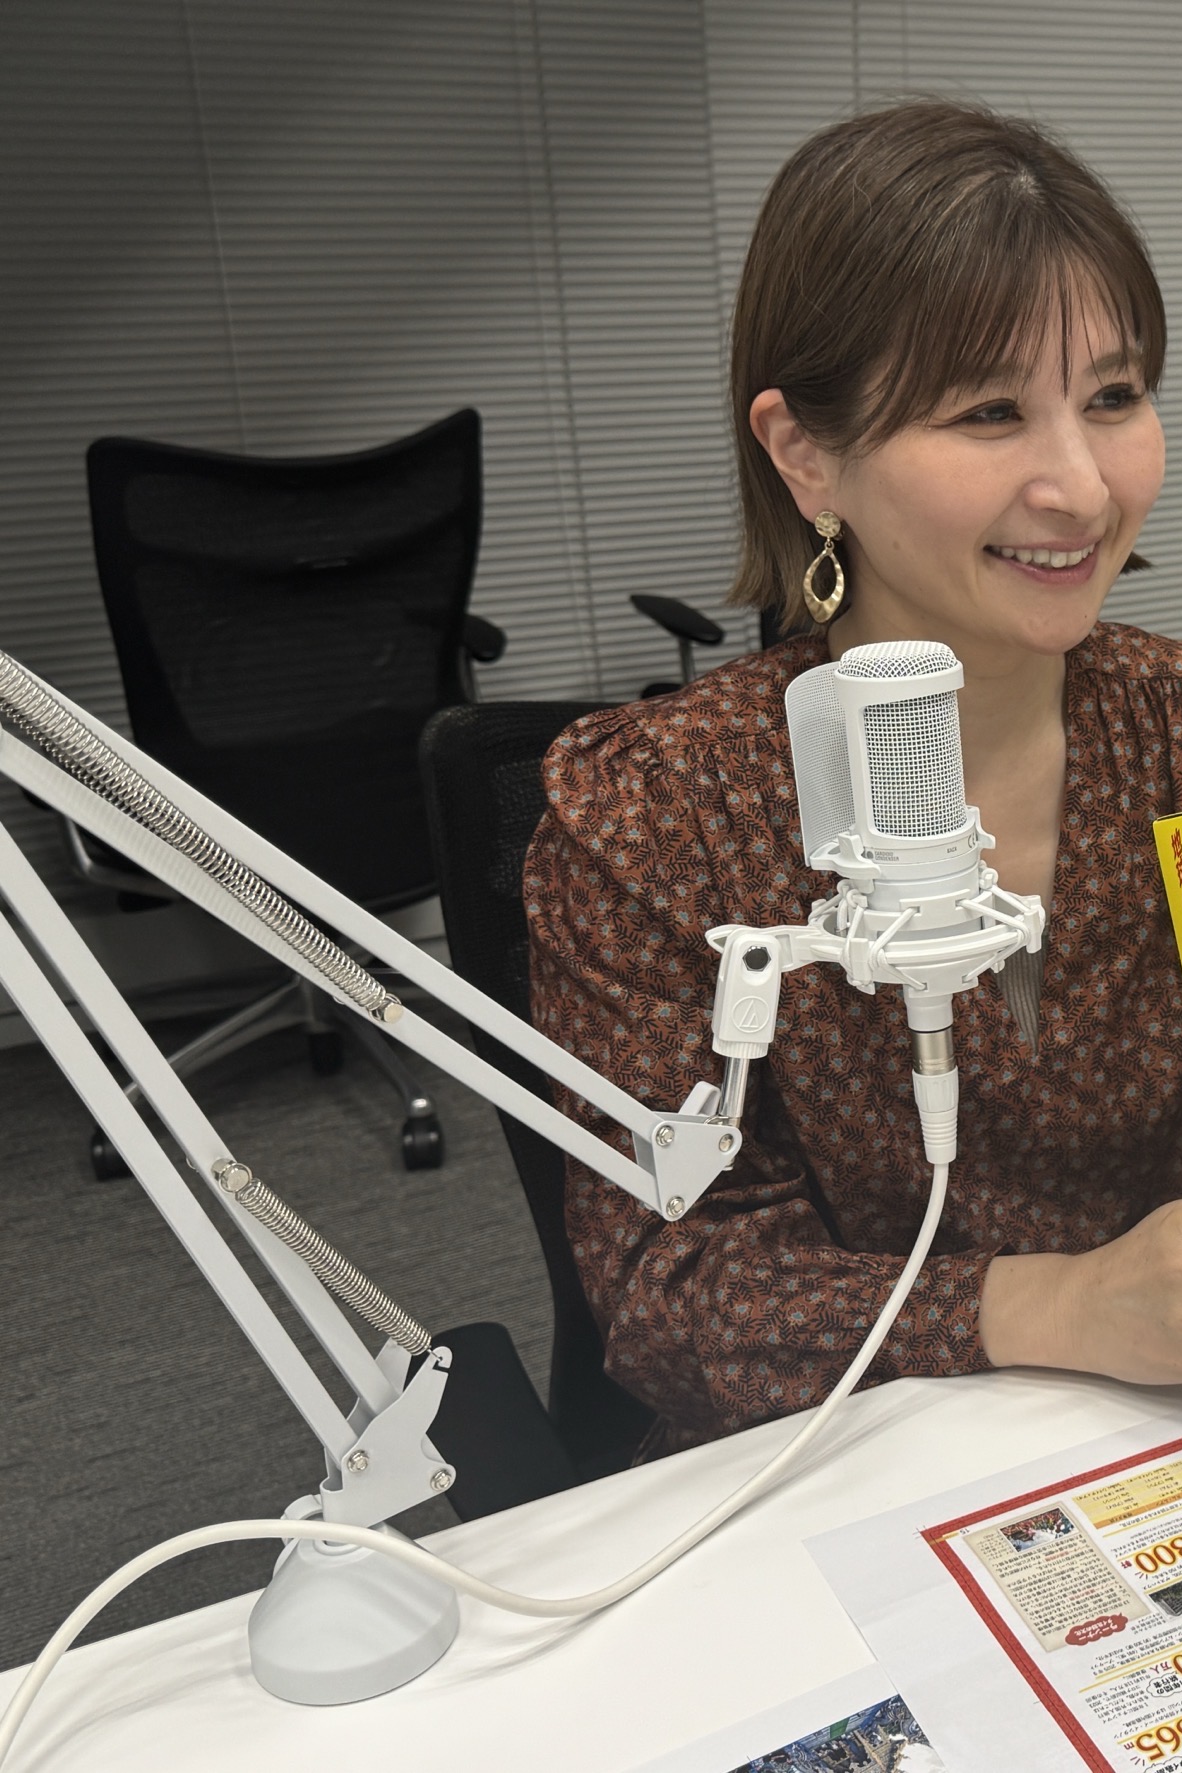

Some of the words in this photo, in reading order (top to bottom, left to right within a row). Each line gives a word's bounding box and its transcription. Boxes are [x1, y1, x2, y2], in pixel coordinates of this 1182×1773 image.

[1076, 1622, 1119, 1643] ラーンナー
[1151, 1673, 1179, 1689] 旅行者
